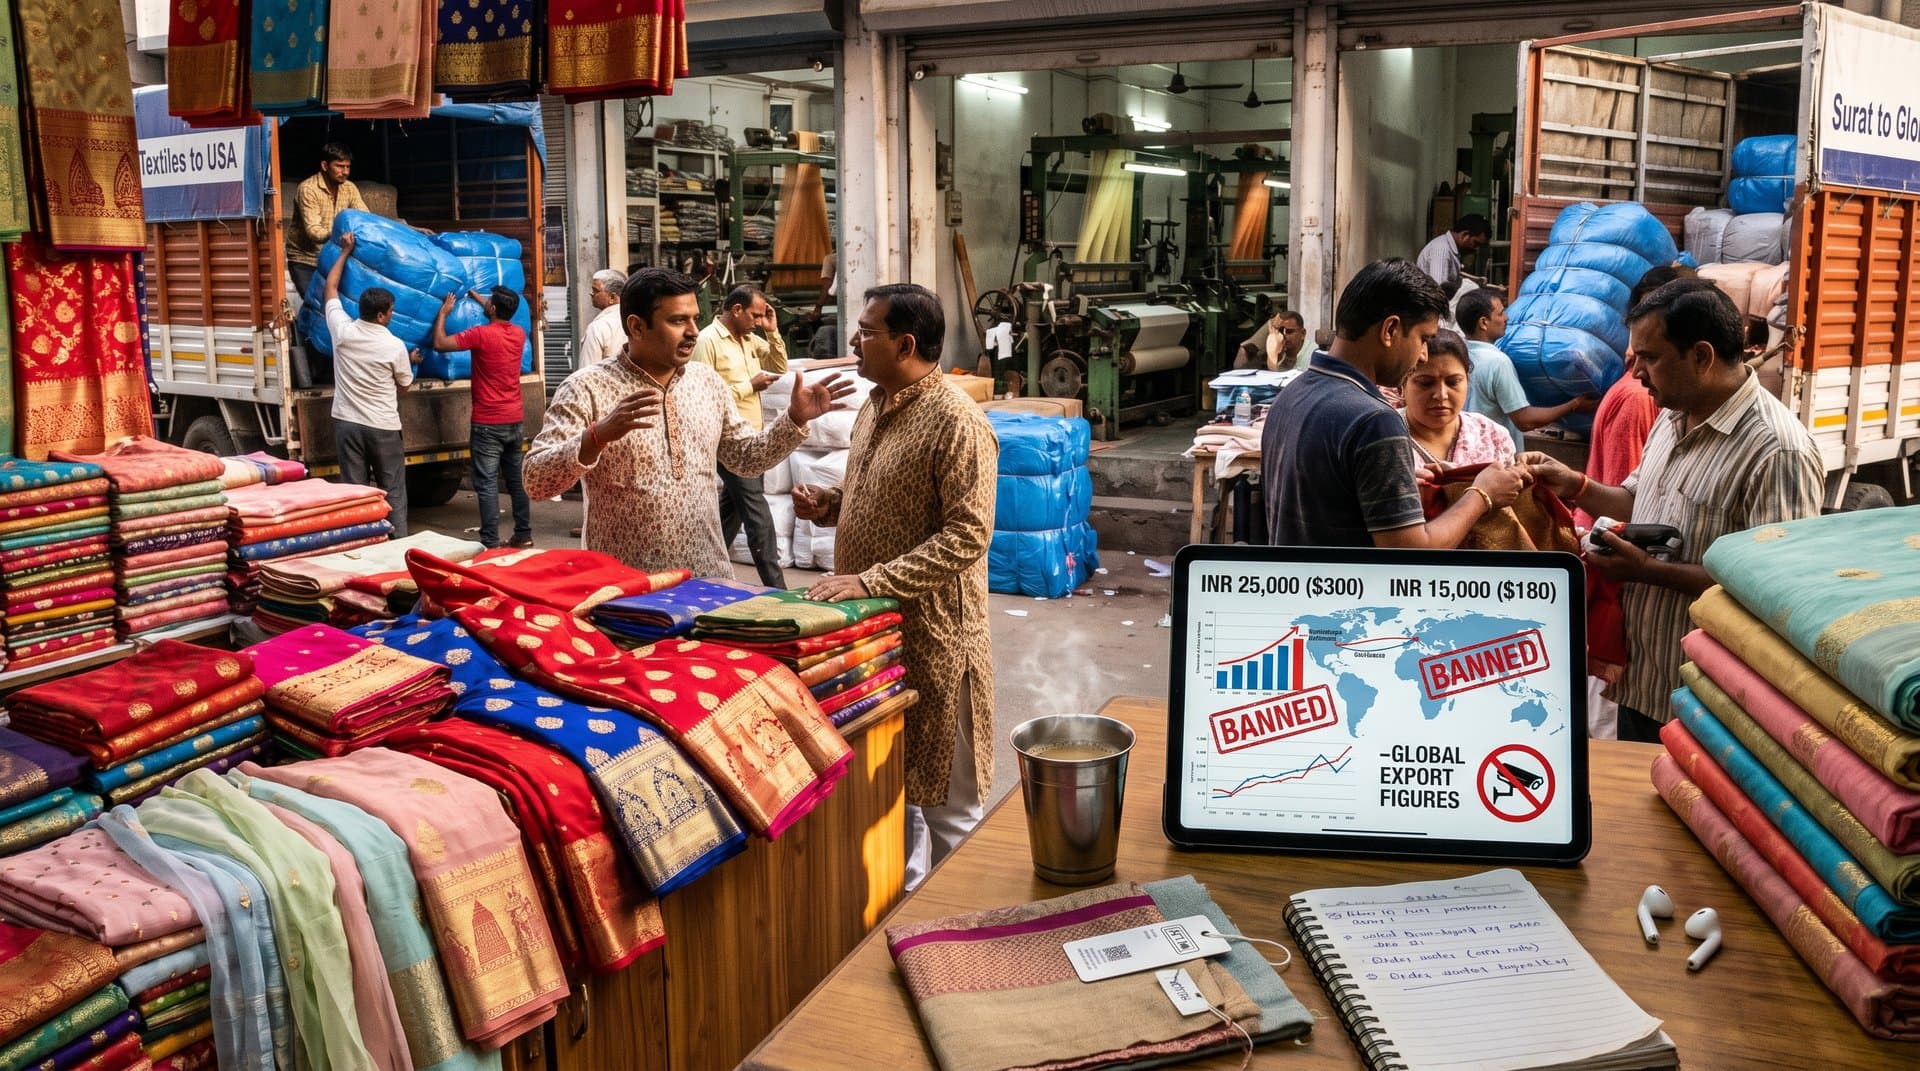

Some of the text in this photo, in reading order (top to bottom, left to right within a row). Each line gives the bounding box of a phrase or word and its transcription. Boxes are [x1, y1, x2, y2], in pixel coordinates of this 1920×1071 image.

[1832, 92, 1920, 143] Surat to Glo
[139, 141, 238, 176] Textiles to USA
[1201, 574, 1364, 599] INR 25,000 ($300)
[1390, 578, 1557, 604] INR 15,000 ($180)
[1431, 641, 1538, 691] BANNED
[1220, 697, 1327, 744] BANNED
[1380, 766, 1454, 786] EXPORT
[1380, 789, 1460, 809] FIGURES
